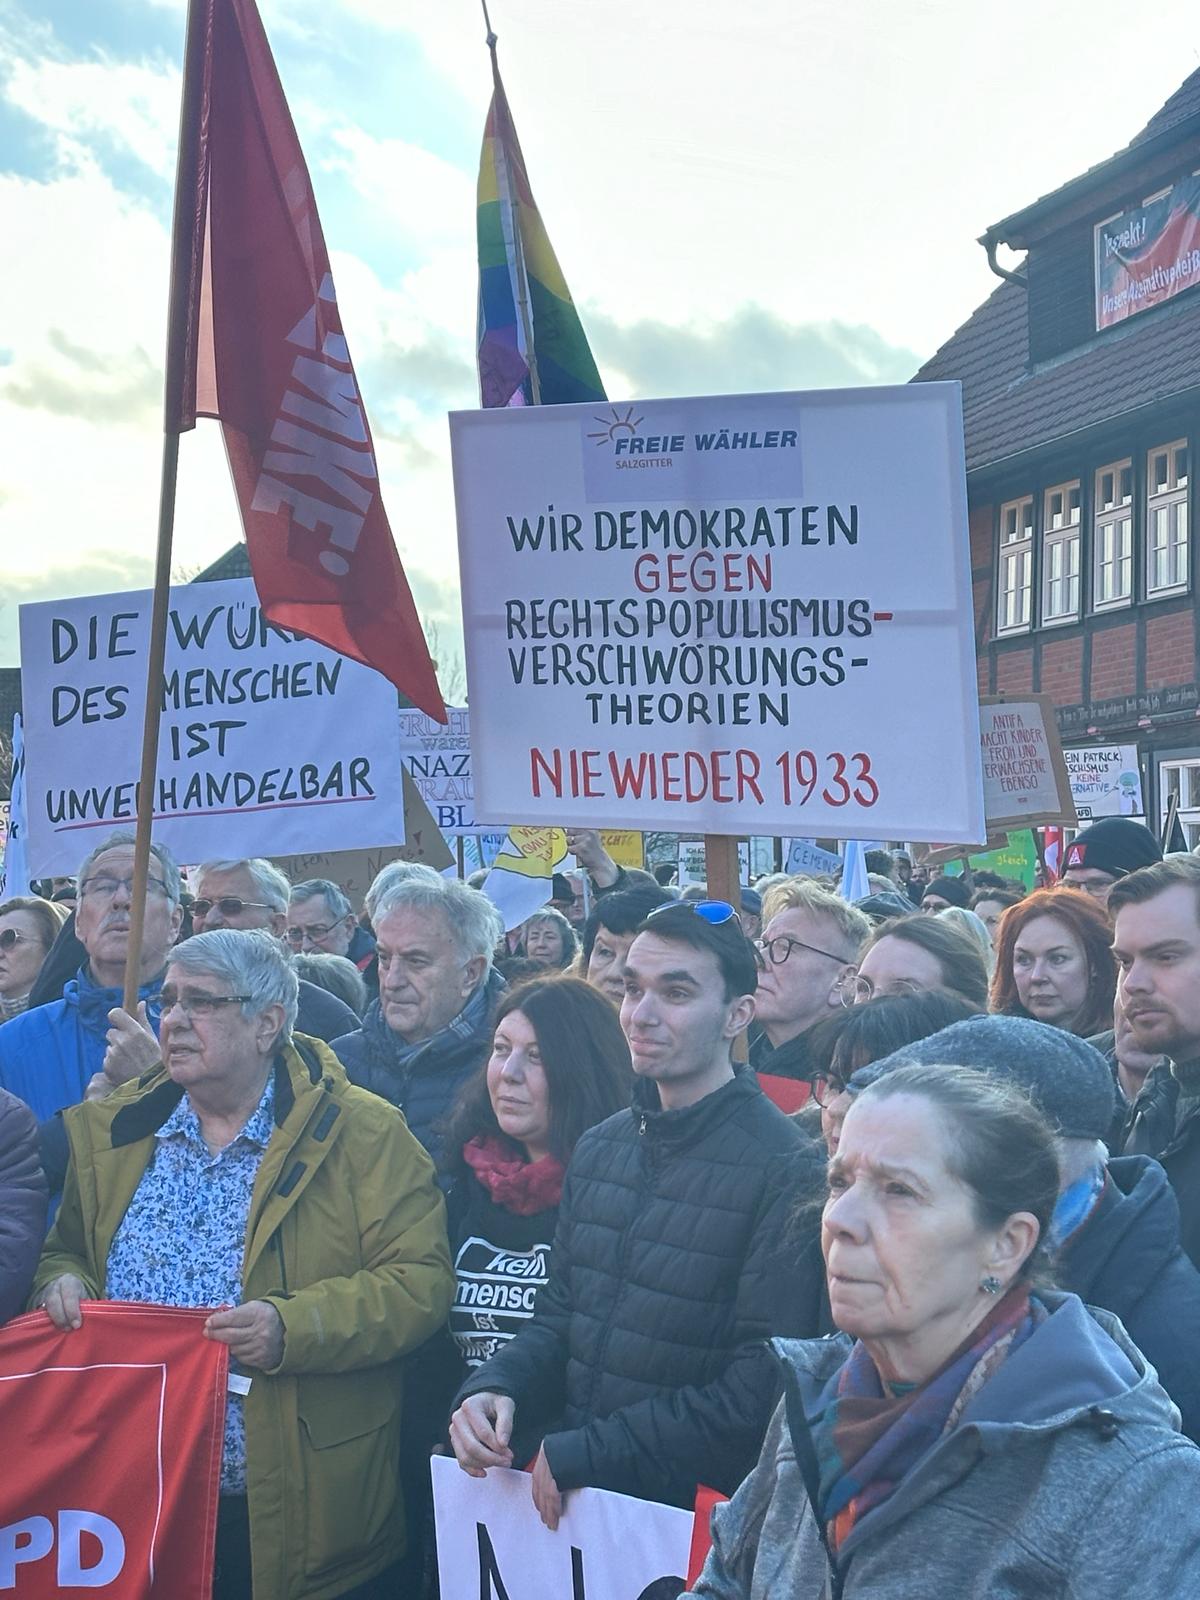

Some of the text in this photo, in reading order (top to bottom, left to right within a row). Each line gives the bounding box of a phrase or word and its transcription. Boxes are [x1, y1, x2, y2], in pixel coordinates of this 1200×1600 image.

[615, 428, 797, 456] FREIE WÄHLER
[615, 457, 673, 469] SALZGITTER
[594, 504, 859, 551] DEMOKRATEN
[634, 551, 773, 593] GEGEN
[51, 601, 307, 665] DIE WÜR
[508, 642, 869, 687] VERSCHWÖRUNGS-
[51, 658, 342, 727] DES MENSCHEN
[585, 692, 790, 726] THEORIEN
[992, 714, 1024, 731] ANTIFA
[170, 720, 247, 761] IST
[420, 737, 471, 751] ware
[1011, 728, 1043, 745] KINDER
[989, 744, 1037, 762] FROH UND
[408, 754, 471, 779] NAZ
[776, 750, 880, 808] 1933
[985, 758, 1047, 779] ERWACHSENE
[1077, 774, 1101, 783] KEINE
[46, 757, 374, 823] UNVEHANDELBAR
[415, 777, 474, 802] RA
[1000, 775, 1039, 793] EBENSO
[436, 805, 476, 828] BL
[0, 1509, 126, 1590] PD
